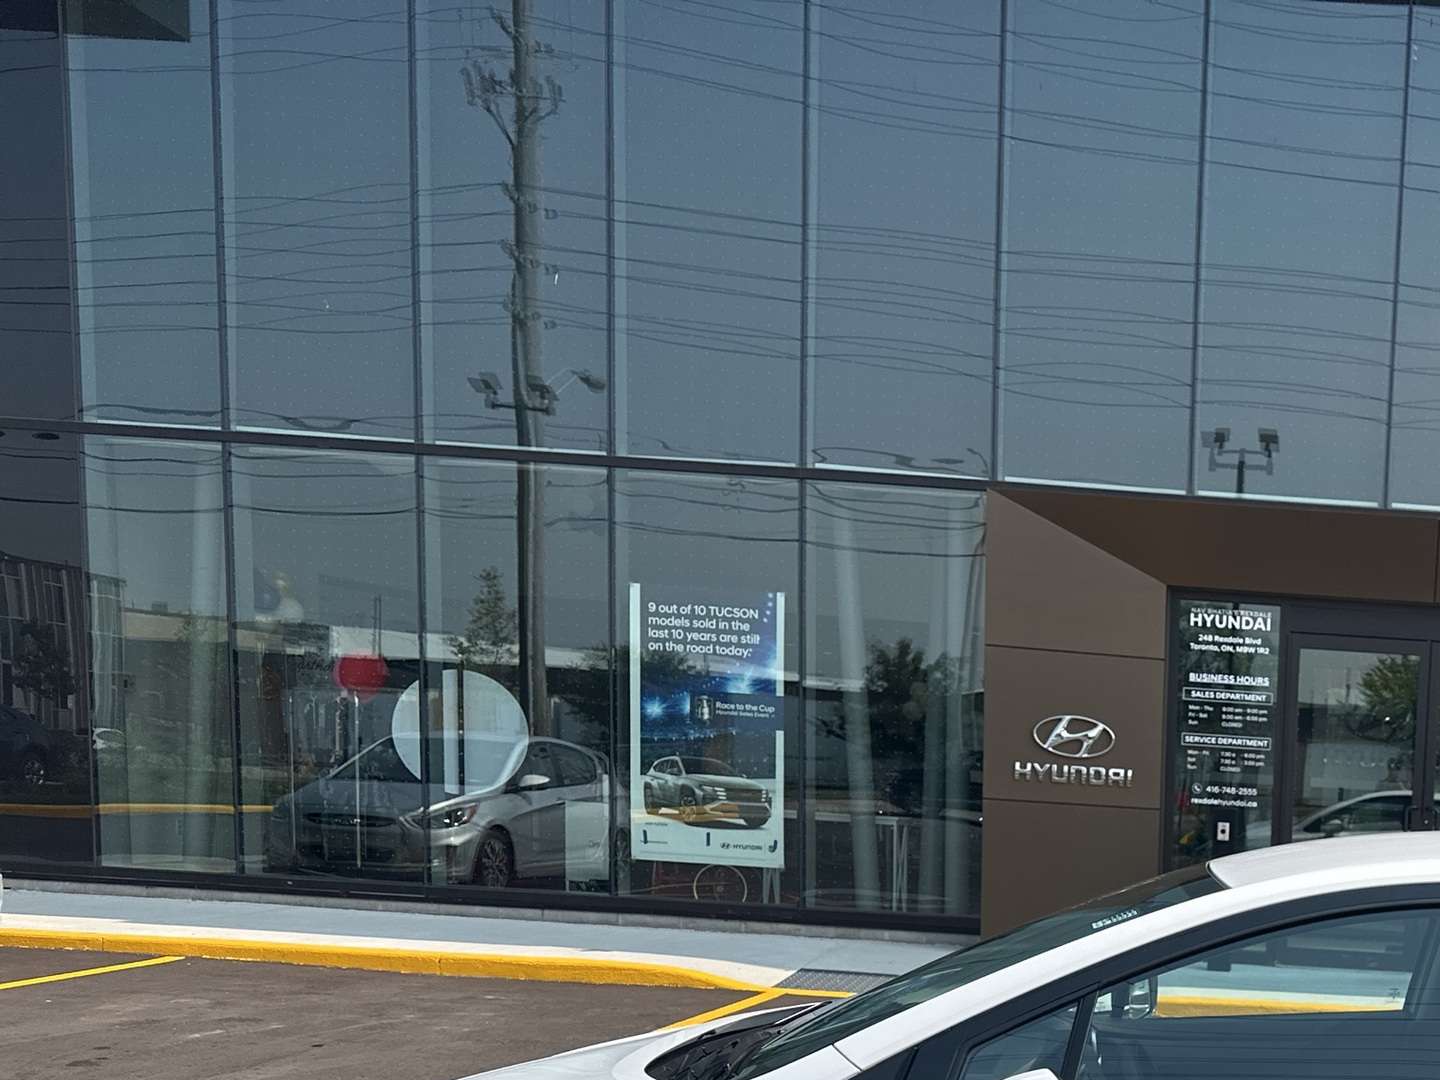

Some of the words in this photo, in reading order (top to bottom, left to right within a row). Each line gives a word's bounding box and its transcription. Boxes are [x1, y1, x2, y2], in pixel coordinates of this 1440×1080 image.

[648, 602, 656, 612] 9
[658, 604, 678, 614] out
[680, 604, 692, 615] of
[694, 605, 706, 616] 10
[709, 606, 759, 619] TUCSON
[648, 616, 690, 628] models
[692, 618, 716, 629] sold
[719, 619, 729, 630] in
[731, 620, 750, 632] the
[1190, 612, 1272, 631] HYUNDAI
[648, 627, 669, 638] last
[671, 629, 684, 639] 10
[686, 631, 717, 642] years
[719, 634, 738, 643] are
[740, 633, 760, 645] still
[1245, 637, 1262, 645] Blvd
[648, 642, 663, 651] on
[665, 641, 685, 652] the
[687, 643, 713, 654] road
[1189, 642, 1220, 652] Toronto,
[1220, 645, 1235, 653] ON,
[1189, 672, 1235, 684] BUSINESS
[1236, 675, 1270, 687] HOURS
[1191, 690, 1215, 699] SALES
[1216, 691, 1267, 702] DEPARTMENT
[716, 701, 735, 710] Race
[758, 704, 775, 713] Cup
[1184, 735, 1217, 744] SERVICE
[1218, 737, 1268, 747] DEPARTMENT
[1014, 761, 1133, 788] HYUNDAI
